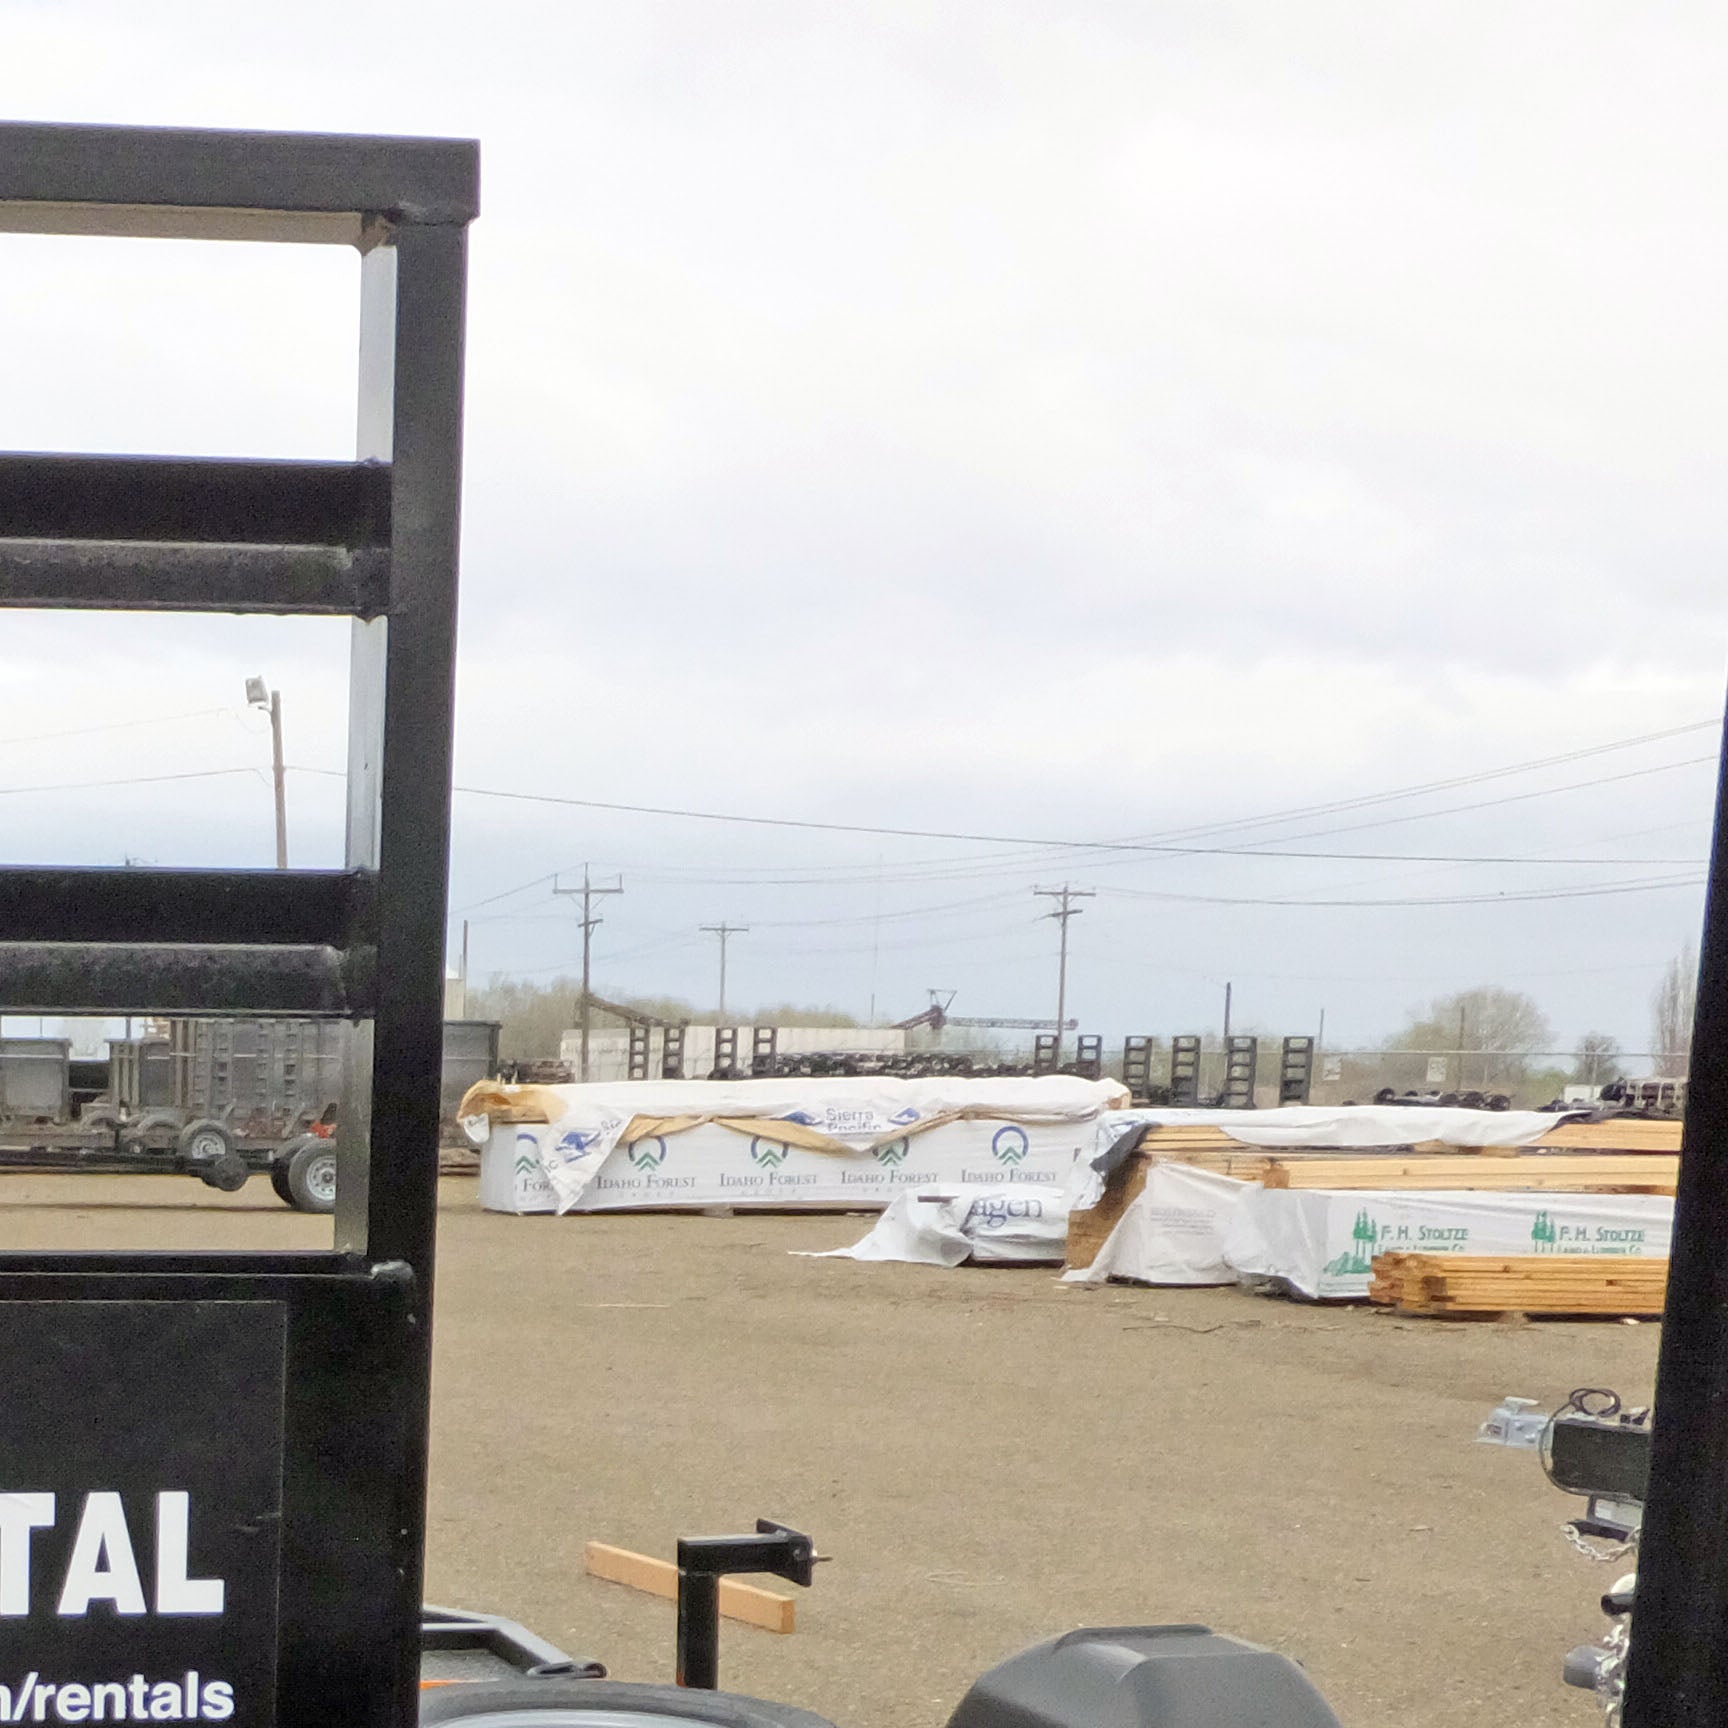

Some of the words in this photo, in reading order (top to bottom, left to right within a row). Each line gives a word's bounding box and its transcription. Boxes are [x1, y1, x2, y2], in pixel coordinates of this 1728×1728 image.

[596, 1175, 642, 1190] IDAHO
[719, 1172, 765, 1187] IDAHO
[840, 1170, 886, 1185] IDAHO
[961, 1168, 1005, 1183] IDAHO
